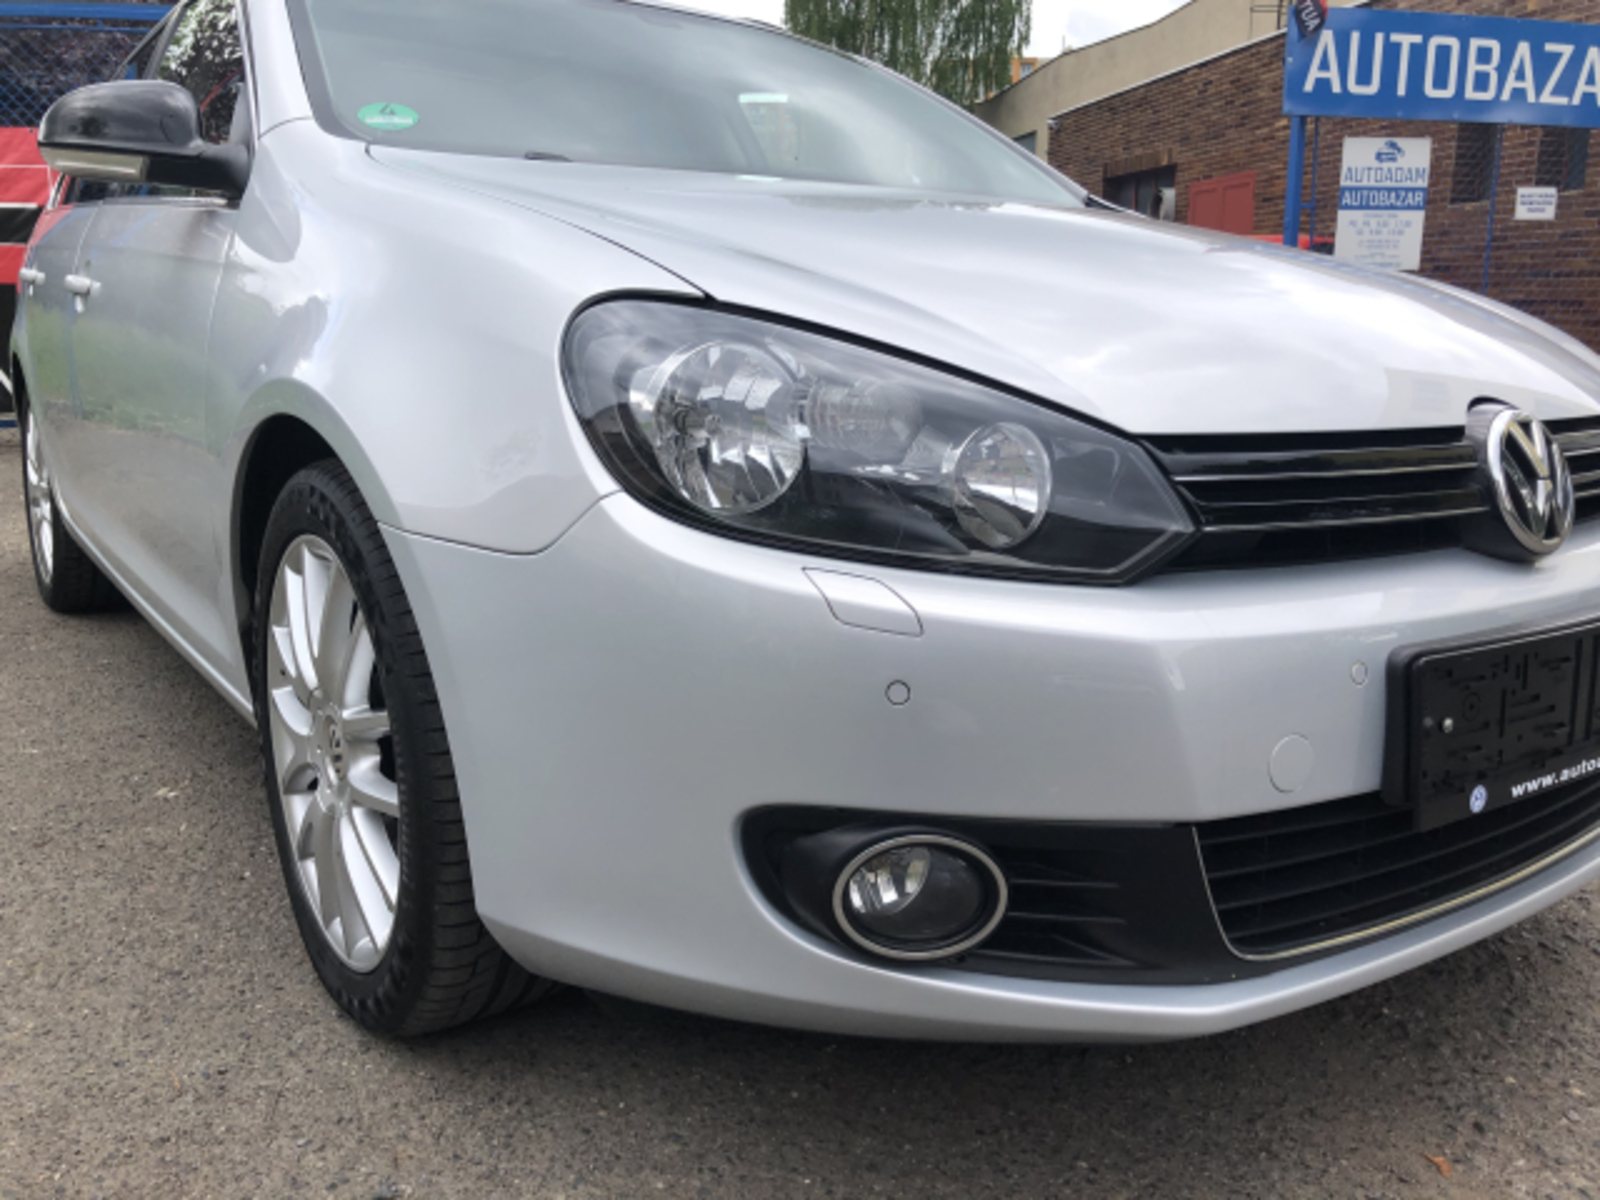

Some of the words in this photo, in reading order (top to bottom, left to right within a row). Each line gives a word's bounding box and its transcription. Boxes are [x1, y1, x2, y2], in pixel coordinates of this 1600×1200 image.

[1303, 29, 1600, 106] AUTOBAZA
[1344, 166, 1426, 183] AUTOADAM
[1342, 189, 1424, 206] AUTOBAZAR
